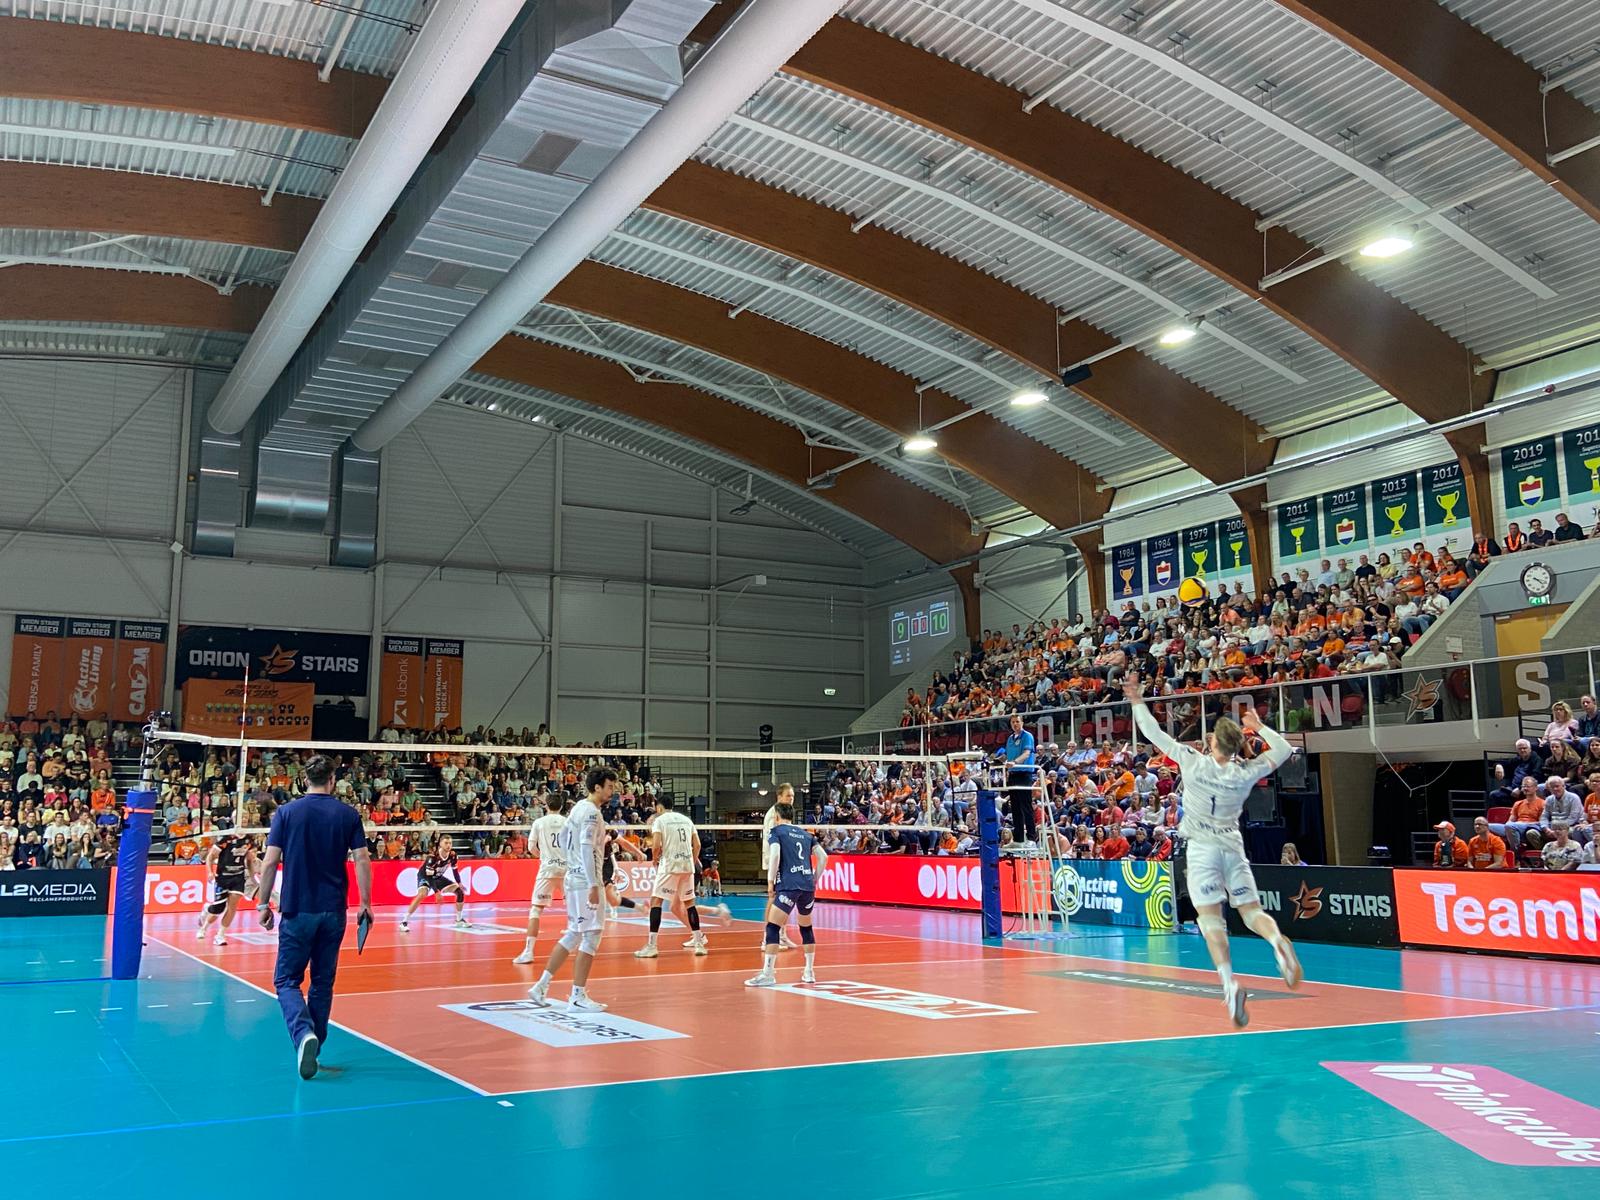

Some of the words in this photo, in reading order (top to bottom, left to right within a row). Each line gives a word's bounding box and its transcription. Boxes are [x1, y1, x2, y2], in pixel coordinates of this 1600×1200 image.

[1576, 429, 1600, 445] 201
[1513, 443, 1543, 461] 2019
[1432, 464, 1459, 481] 2017
[1381, 478, 1407, 493] 2013
[1332, 491, 1356, 505] 2012
[1286, 502, 1309, 517] 2011
[1189, 527, 1208, 541] 1979
[1154, 538, 1171, 550] 1984
[1119, 547, 1135, 559] 1984
[20, 624, 59, 634] MEMBER
[932, 612, 947, 631] 10
[72, 627, 110, 637] MEMBER
[124, 630, 161, 640] MEMBER
[897, 622, 905, 639] 9
[388, 644, 418, 653] MEMBER
[429, 647, 460, 655] MEMBER
[31, 644, 42, 677] FAMILY
[80, 648, 91, 688] Active
[90, 645, 103, 684] Living
[189, 649, 250, 667] ORION
[302, 655, 359, 673] STARS
[396, 658, 409, 698] ubbink
[1209, 795, 1216, 816] 1
[676, 828, 686, 843] 13
[796, 841, 804, 860] 2
[1080, 876, 1118, 894] Active
[1084, 893, 1123, 914] Living
[1329, 893, 1393, 918] STARS
[1416, 1083, 1600, 1162] Pinkcube
